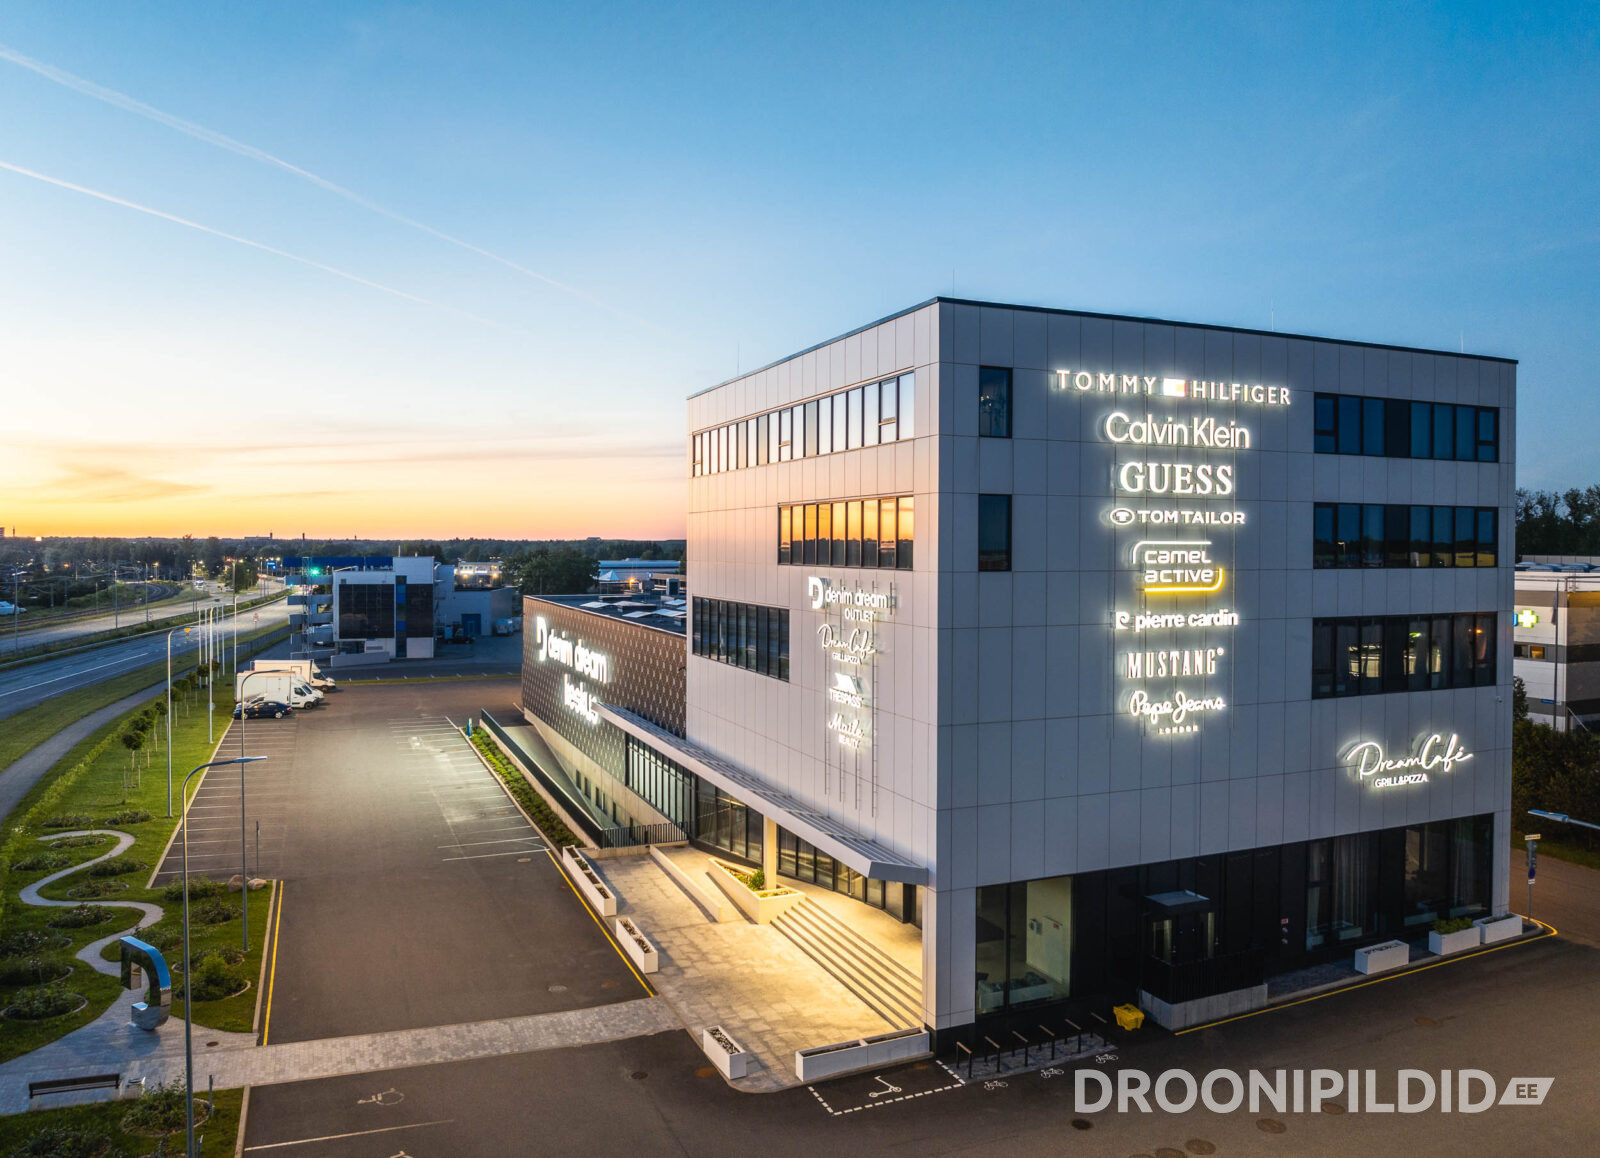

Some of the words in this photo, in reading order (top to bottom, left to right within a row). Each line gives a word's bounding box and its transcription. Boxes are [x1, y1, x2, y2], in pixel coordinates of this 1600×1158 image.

[1056, 369, 1157, 396] TOMMY
[1192, 380, 1292, 406] HILFIGER
[1105, 412, 1188, 446] Calvin
[1193, 417, 1251, 449] Klein
[1119, 462, 1233, 496] GUESS
[825, 587, 854, 606] denim
[854, 589, 889, 609] dream
[844, 607, 876, 624] OUTLET
[1134, 610, 1186, 632] pierre
[1187, 609, 1239, 627] cardin
[1129, 690, 1174, 724] Pepe
[1171, 690, 1227, 723] Jeans
